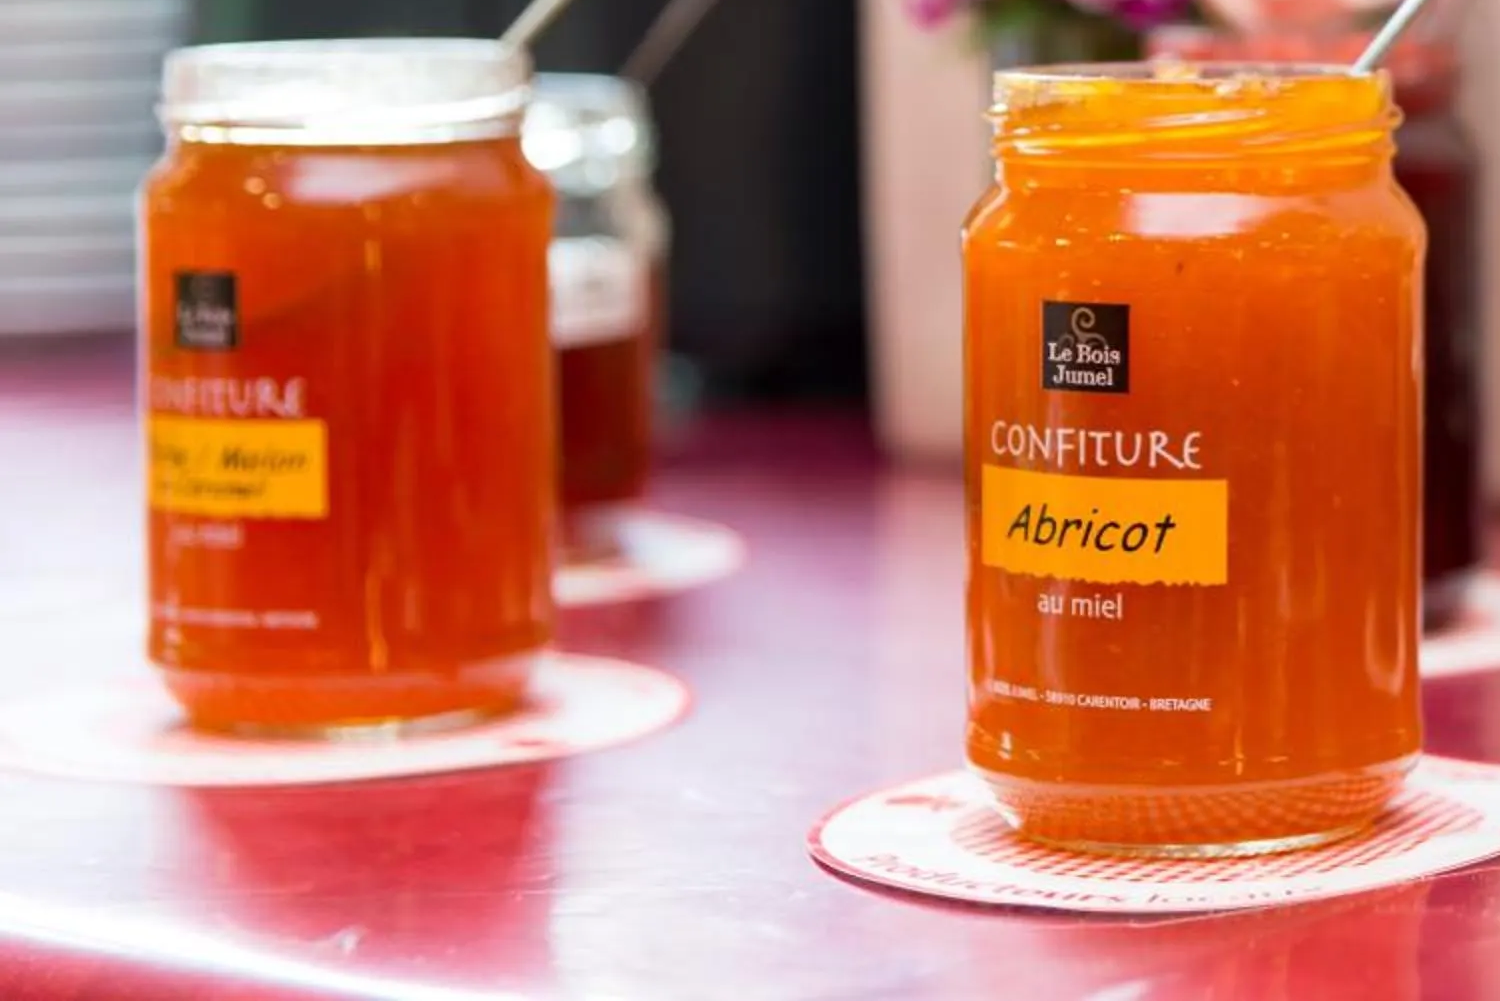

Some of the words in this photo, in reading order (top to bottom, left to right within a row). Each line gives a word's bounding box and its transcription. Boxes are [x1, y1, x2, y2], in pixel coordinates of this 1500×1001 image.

[1047, 342, 1073, 364] Le
[1076, 343, 1121, 366] Bois
[1053, 365, 1114, 387] Jumel
[991, 420, 1203, 470] CONFITURE
[1006, 503, 1176, 554] Abricot
[1037, 593, 1063, 615] au
[1071, 592, 1123, 619] miel
[1077, 693, 1141, 711] CARENTOIR
[1149, 697, 1212, 712] BRETAGNE
